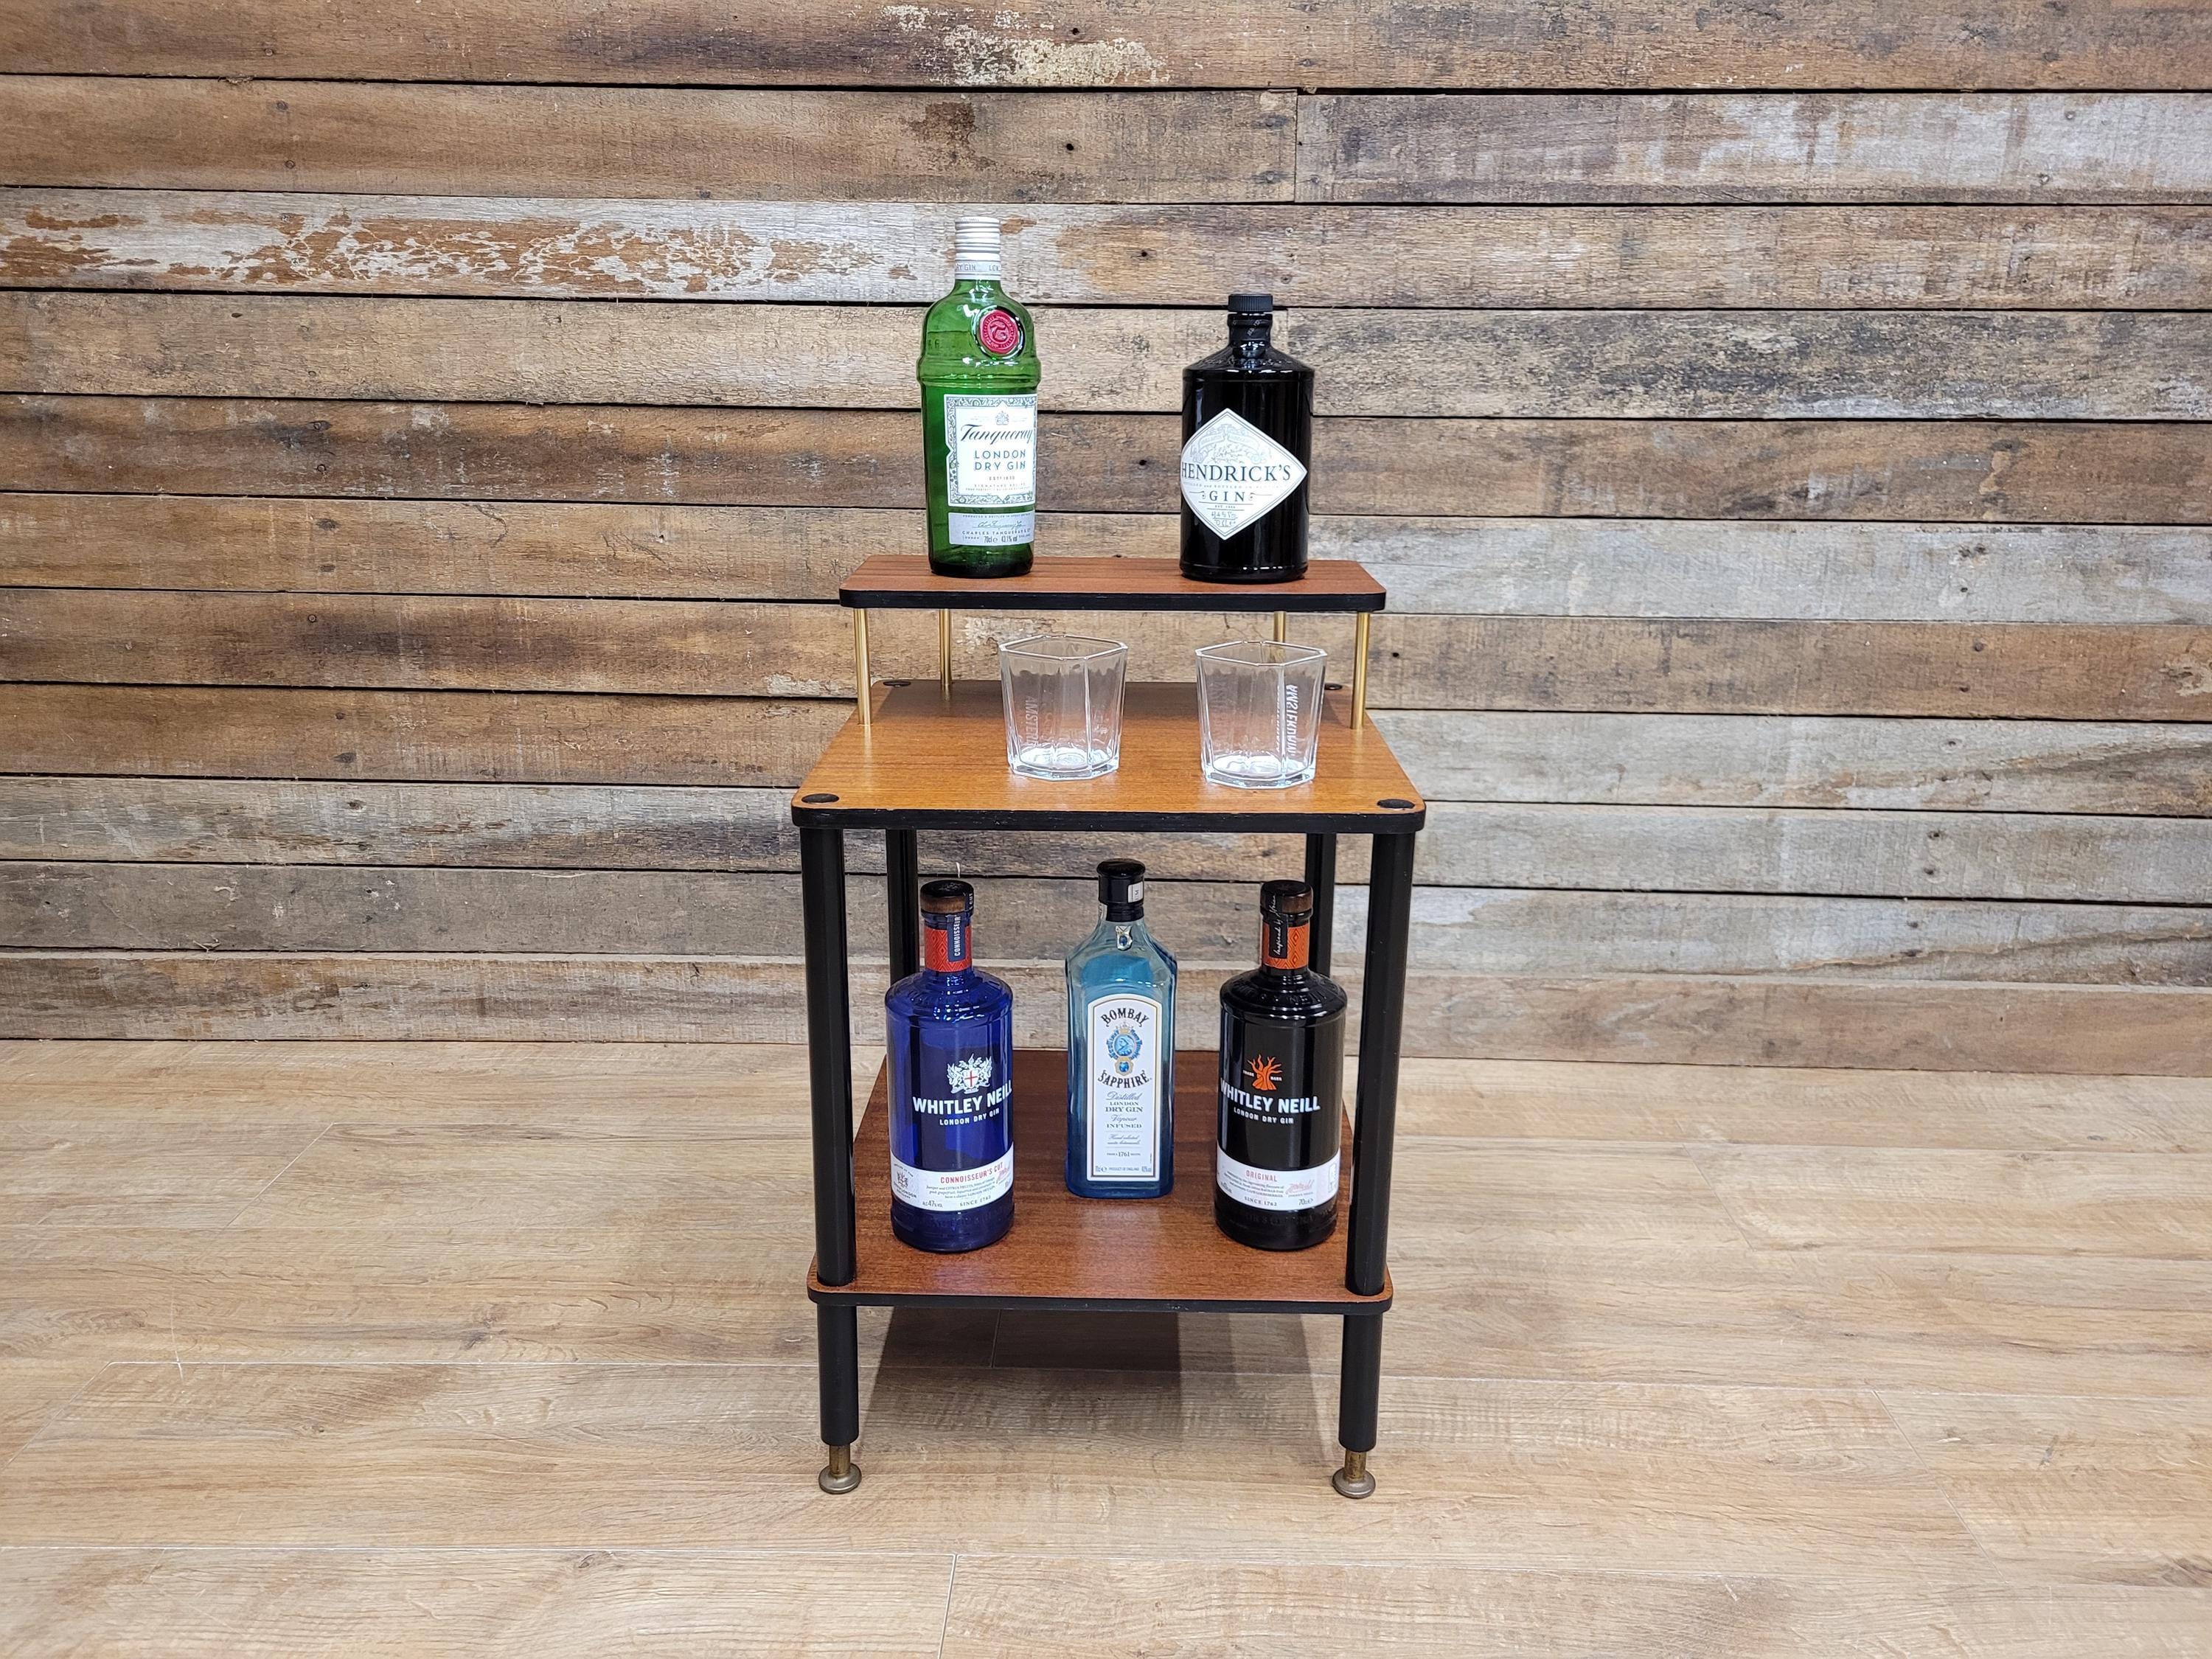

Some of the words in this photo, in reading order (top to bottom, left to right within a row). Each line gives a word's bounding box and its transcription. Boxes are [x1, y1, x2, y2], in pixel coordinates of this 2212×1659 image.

[961, 424, 1033, 445] Tanqueray
[975, 450, 1026, 459] LONDON
[975, 462, 1001, 470] DRY
[1007, 461, 1026, 470] GIN
[1181, 462, 1291, 481] HENDRICK'S
[1209, 490, 1245, 501] GIN
[1100, 1007, 1150, 1027] BOMBAY
[1097, 1070, 1150, 1088] SAPPHIRE
[912, 1096, 983, 1115] WHITLEY
[987, 1079, 1012, 1107] NEILL
[1105, 1091, 1143, 1101] Distilled
[1220, 1077, 1273, 1113] WHITLEY
[1278, 1096, 1321, 1114] NEILL
[939, 1116, 970, 1126] LONDON
[973, 1113, 987, 1122] DRY
[989, 1107, 1000, 1118] GIN
[1234, 1107, 1259, 1121] LONDON
[940, 1167, 992, 1183] CONNOISSEUR'S
[994, 1161, 1004, 1172] CUT
[1246, 1169, 1278, 1182] ORIGINAL
[1244, 1196, 1262, 1204] SINCE
